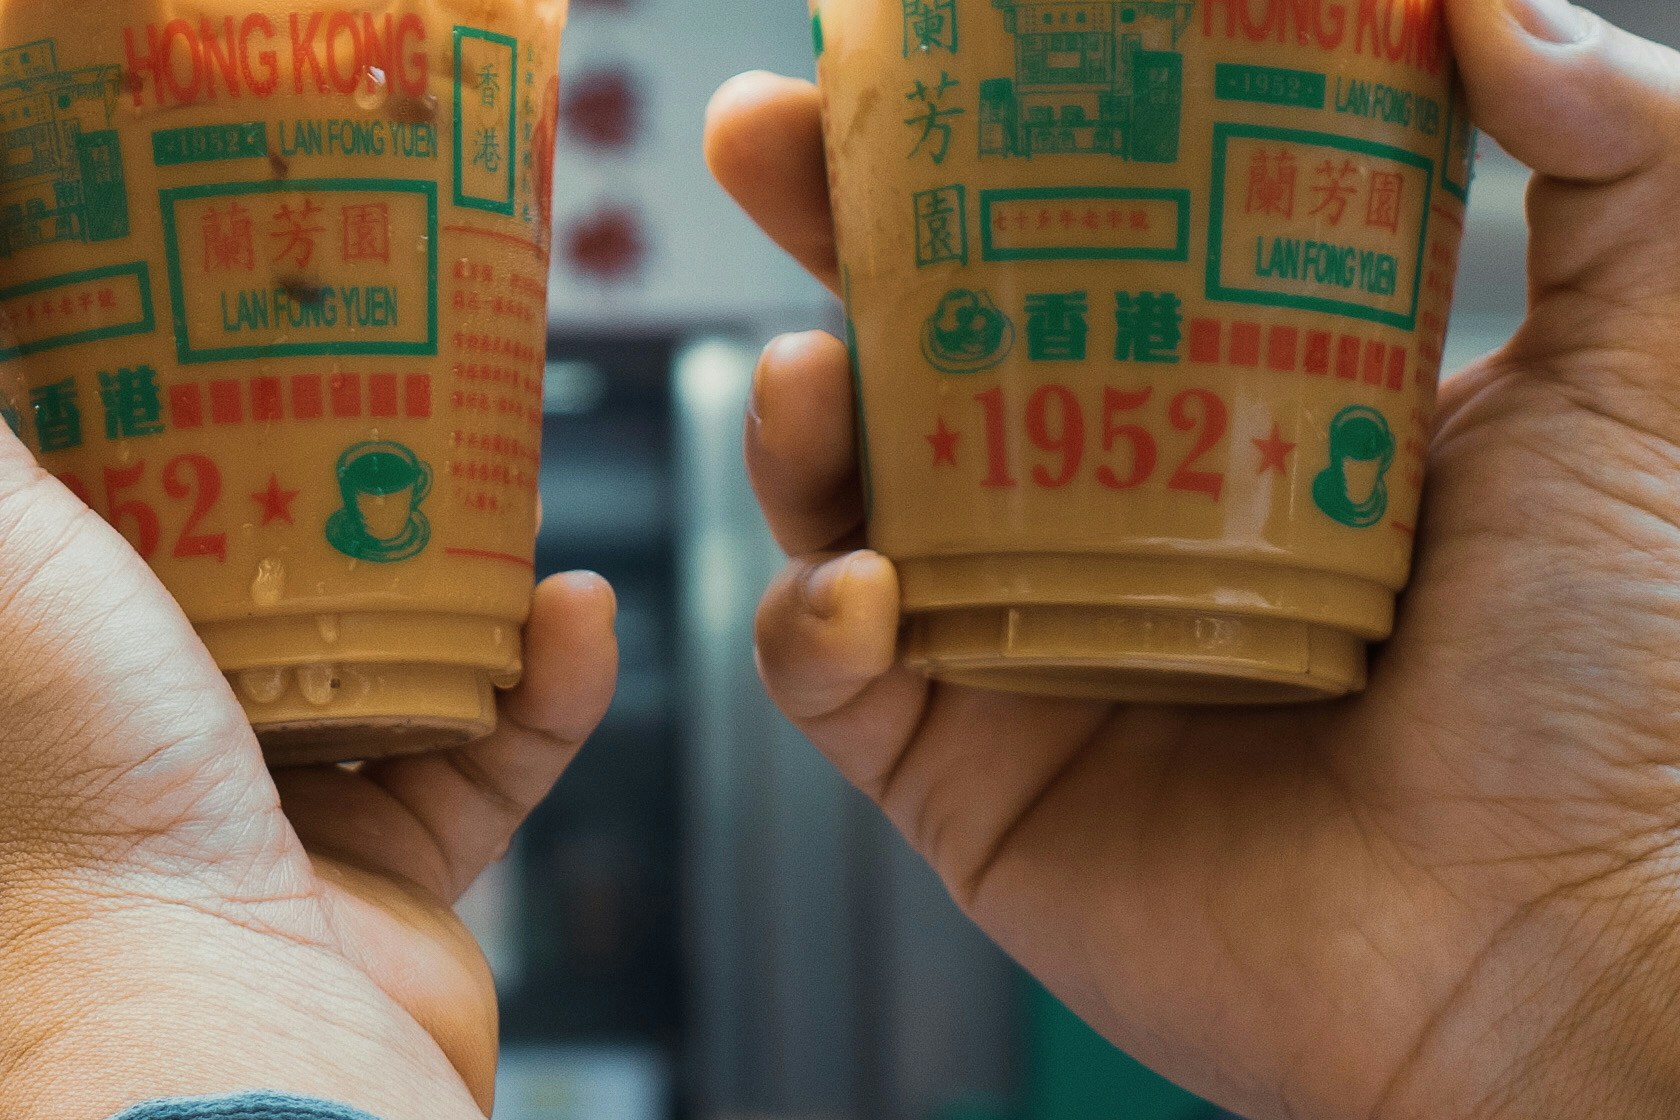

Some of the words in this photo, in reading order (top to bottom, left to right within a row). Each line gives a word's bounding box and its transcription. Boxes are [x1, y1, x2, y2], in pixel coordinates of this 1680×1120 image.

[122, 13, 278, 107] HONG
[291, 11, 429, 101] KONG
[278, 119, 322, 156] LAN
[327, 119, 385, 155] FONG
[390, 121, 438, 158] YUEN
[473, 63, 502, 173] 香港
[1245, 152, 1404, 234] 蘭芳園
[201, 200, 392, 273] 蘭芳園
[1256, 235, 1300, 280] LAN
[1301, 239, 1357, 289] FONG
[222, 288, 269, 333] LAN
[274, 287, 339, 330] FONG
[342, 286, 399, 329] YUEN
[1024, 289, 1183, 364] 香港
[32, 364, 164, 453] 香港
[973, 383, 1228, 502] 1952
[57, 453, 228, 565] 52
